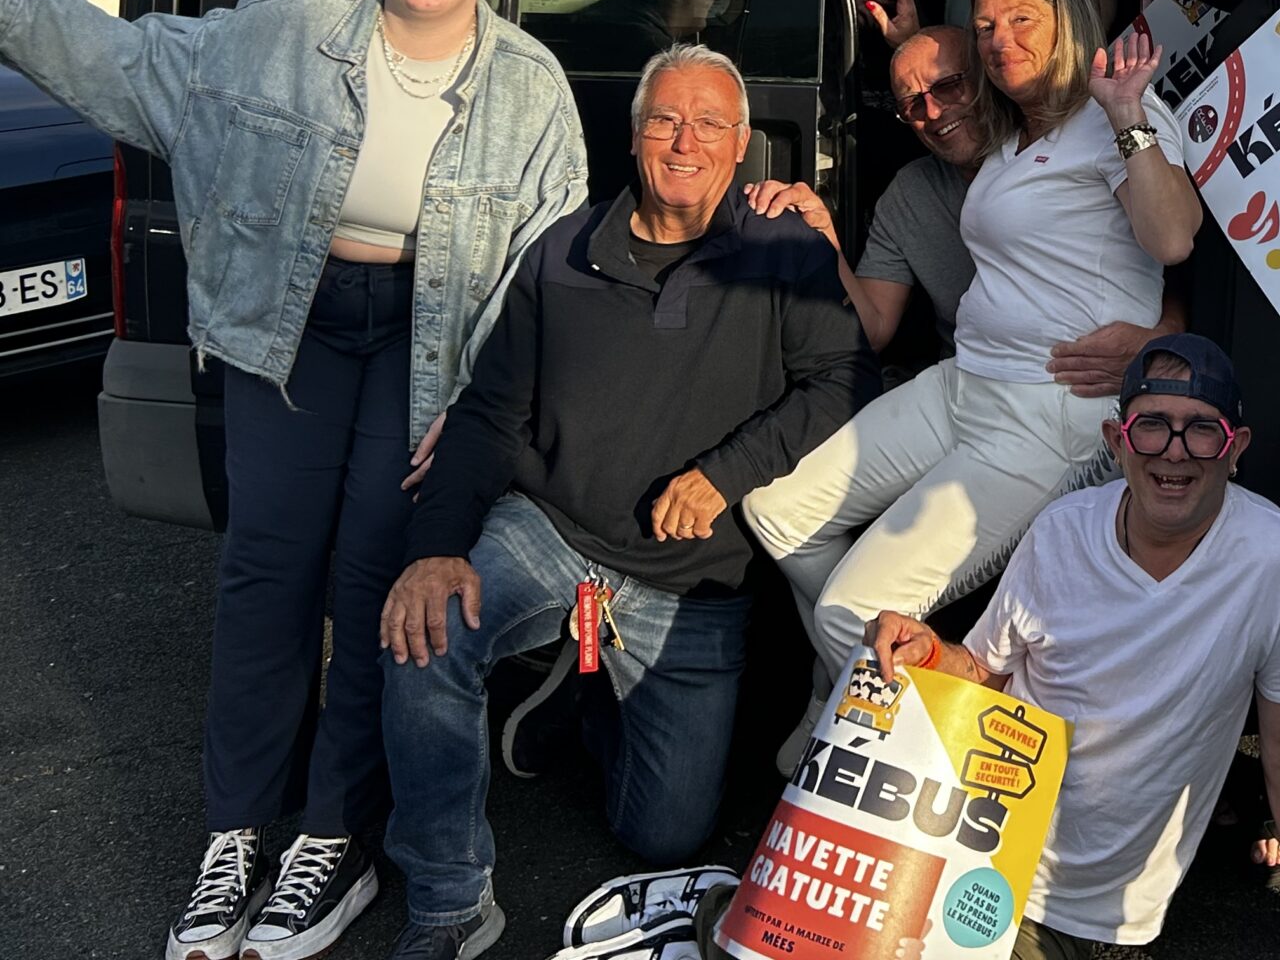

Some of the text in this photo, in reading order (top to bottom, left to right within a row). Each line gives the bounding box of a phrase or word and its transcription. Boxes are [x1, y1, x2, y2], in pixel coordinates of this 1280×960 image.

[67, 280, 84, 295] 64
[989, 718, 1038, 750] FESTAYRES
[980, 761, 1020, 777] EN TOUTE
[766, 820, 894, 891] NAVETTE
[750, 854, 891, 932] GRATUITE
[962, 889, 998, 917] TU AS BU,
[971, 882, 1001, 904] QUAND
[947, 907, 958, 919] LE
[956, 899, 998, 928] TU PRENDS
[761, 930, 795, 953] MÉES
[766, 915, 782, 928] PAR
[784, 922, 795, 934] LA
[796, 928, 832, 947] MAIRIE
[833, 940, 846, 952] DE
